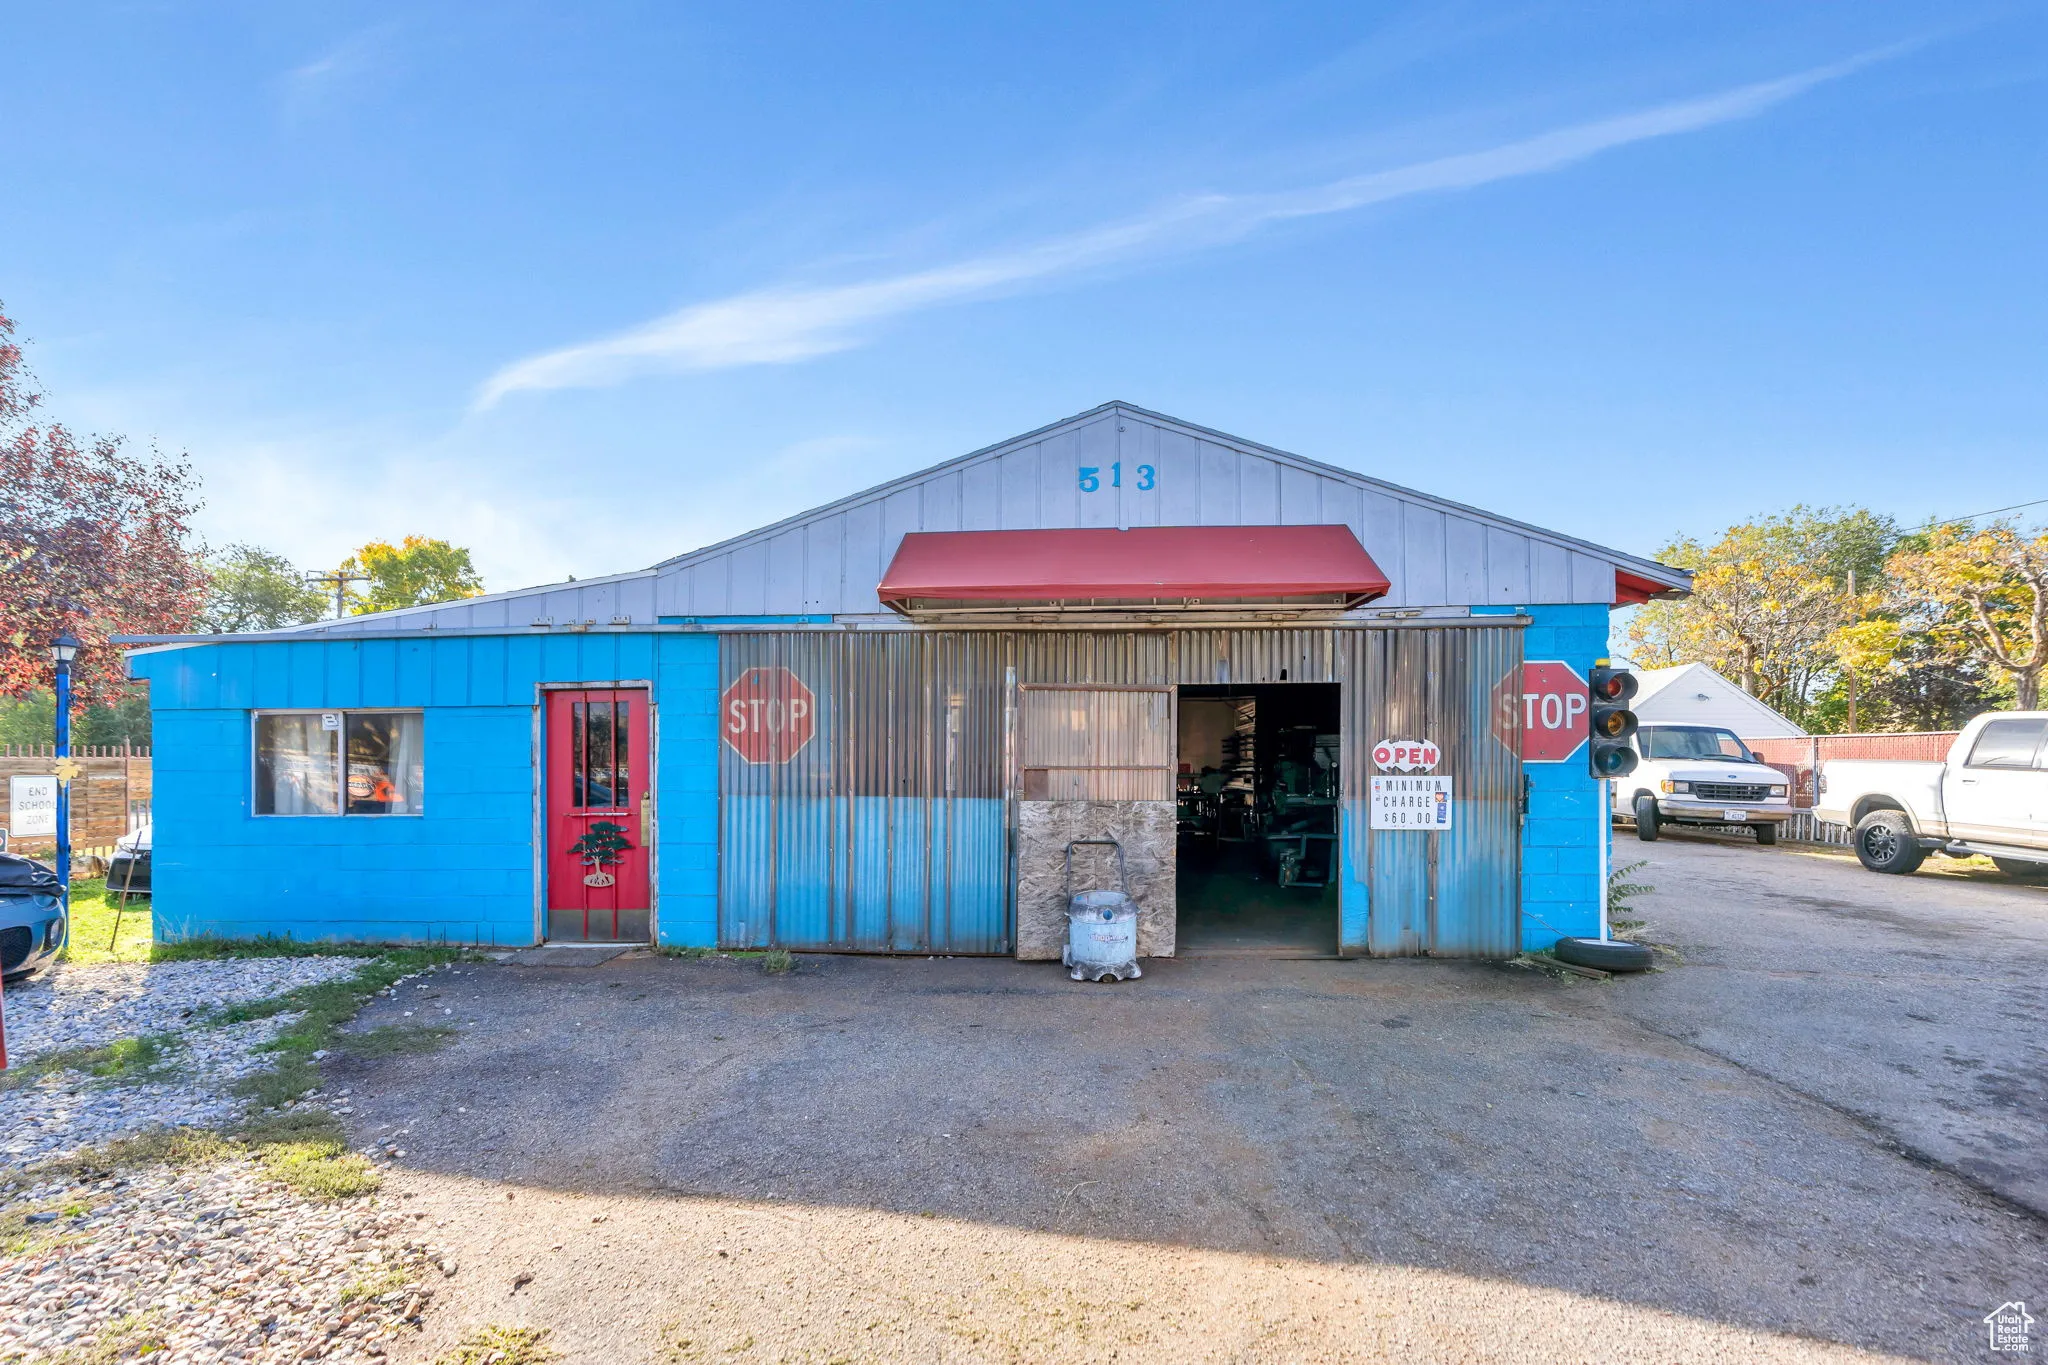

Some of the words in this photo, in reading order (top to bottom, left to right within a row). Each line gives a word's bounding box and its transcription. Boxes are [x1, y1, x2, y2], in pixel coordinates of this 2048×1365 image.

[1078, 461, 1155, 493] 513
[727, 698, 808, 734] STOP
[1499, 692, 1587, 730] STOP
[1374, 747, 1436, 764] OPEN
[28, 787, 48, 796] END
[1386, 780, 1442, 792] MINIMUM
[18, 800, 57, 811] SCHOOL
[1383, 796, 1431, 808] CHARGE
[26, 815, 50, 825] ZONE
[1384, 812, 1431, 824] $60.00
